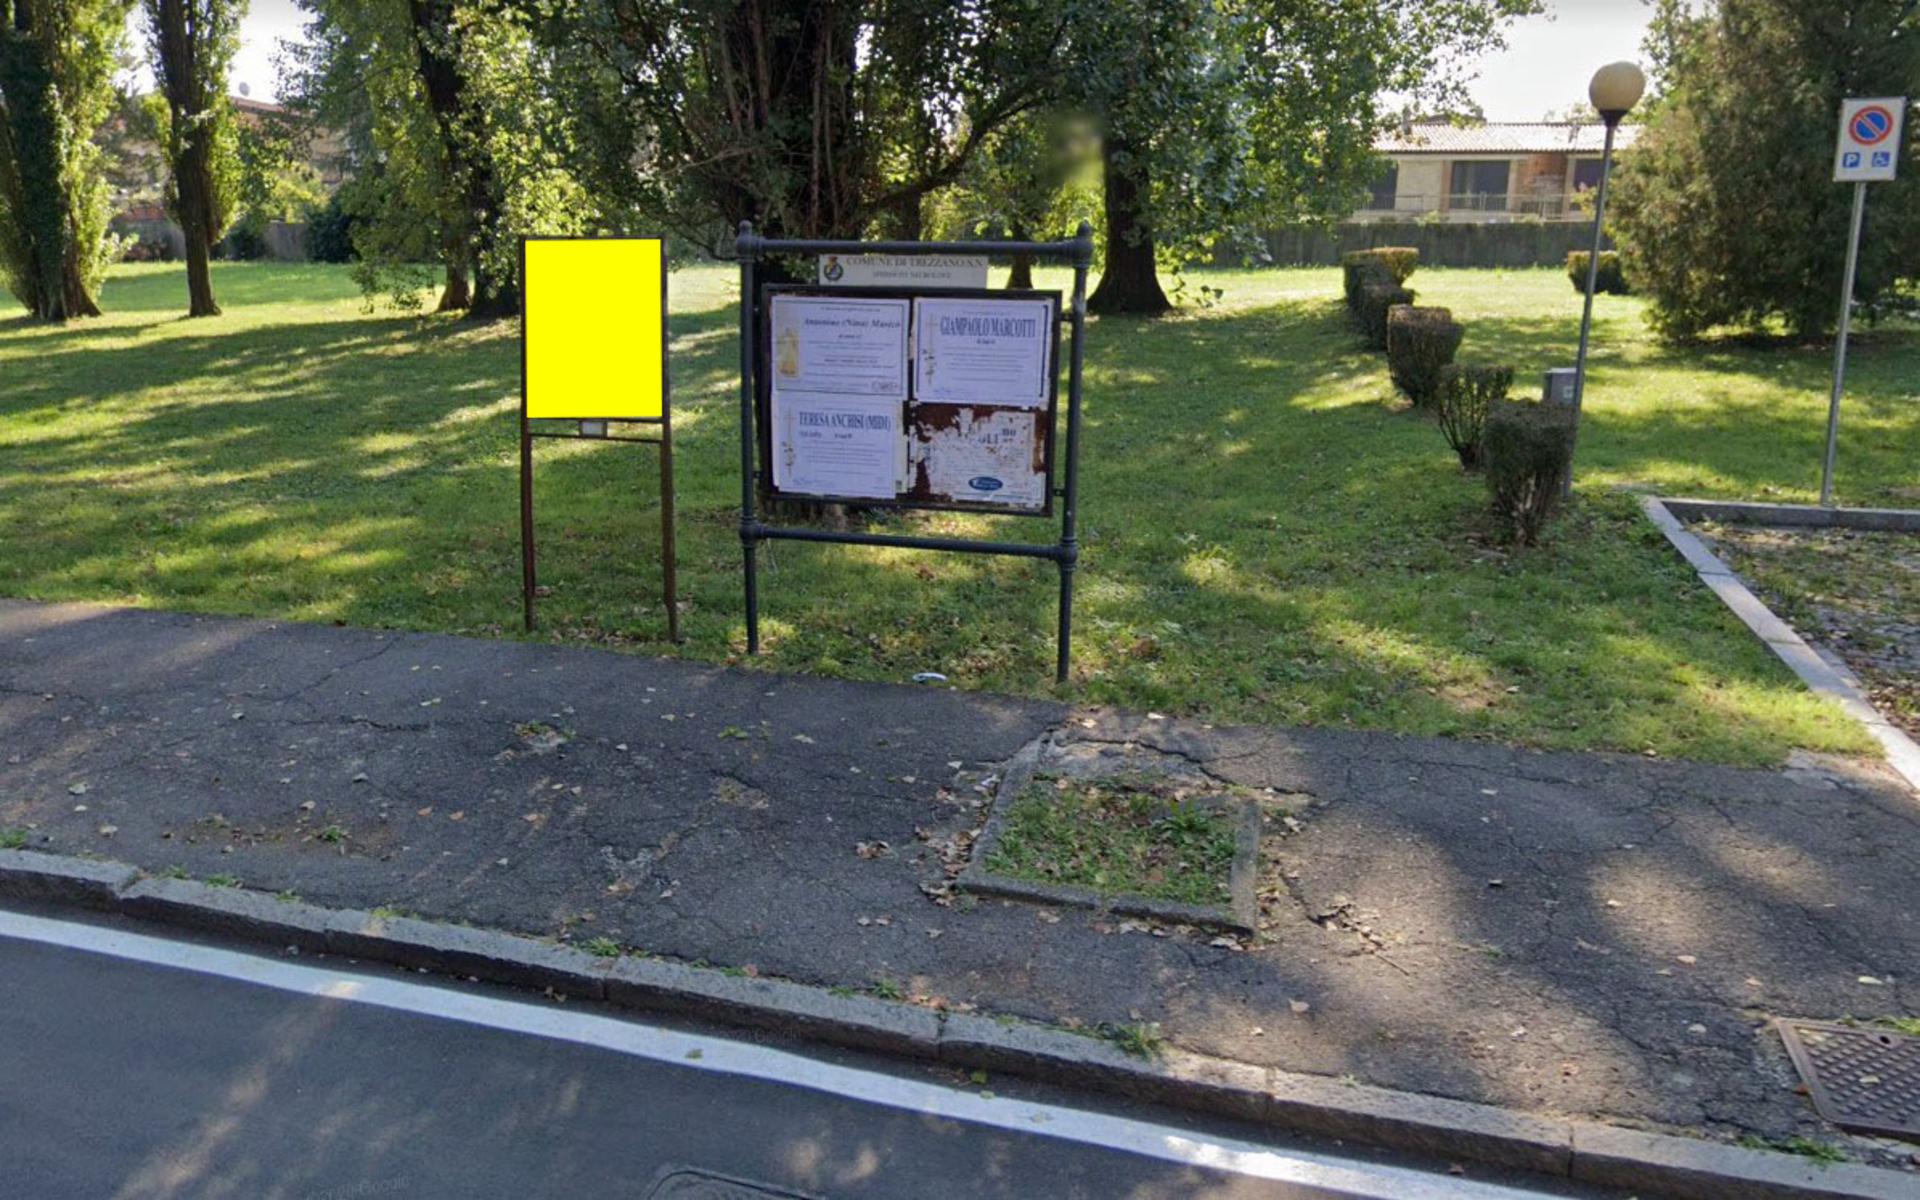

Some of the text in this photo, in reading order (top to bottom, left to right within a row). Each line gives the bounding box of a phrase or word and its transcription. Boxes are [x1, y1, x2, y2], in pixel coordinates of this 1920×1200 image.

[846, 256, 893, 266] COMUNE
[895, 256, 907, 267] DI
[910, 256, 966, 268] TREZZANO
[940, 316, 1036, 338] GIAMPAOLO MARCOTTI
[799, 411, 829, 427] TERESA
